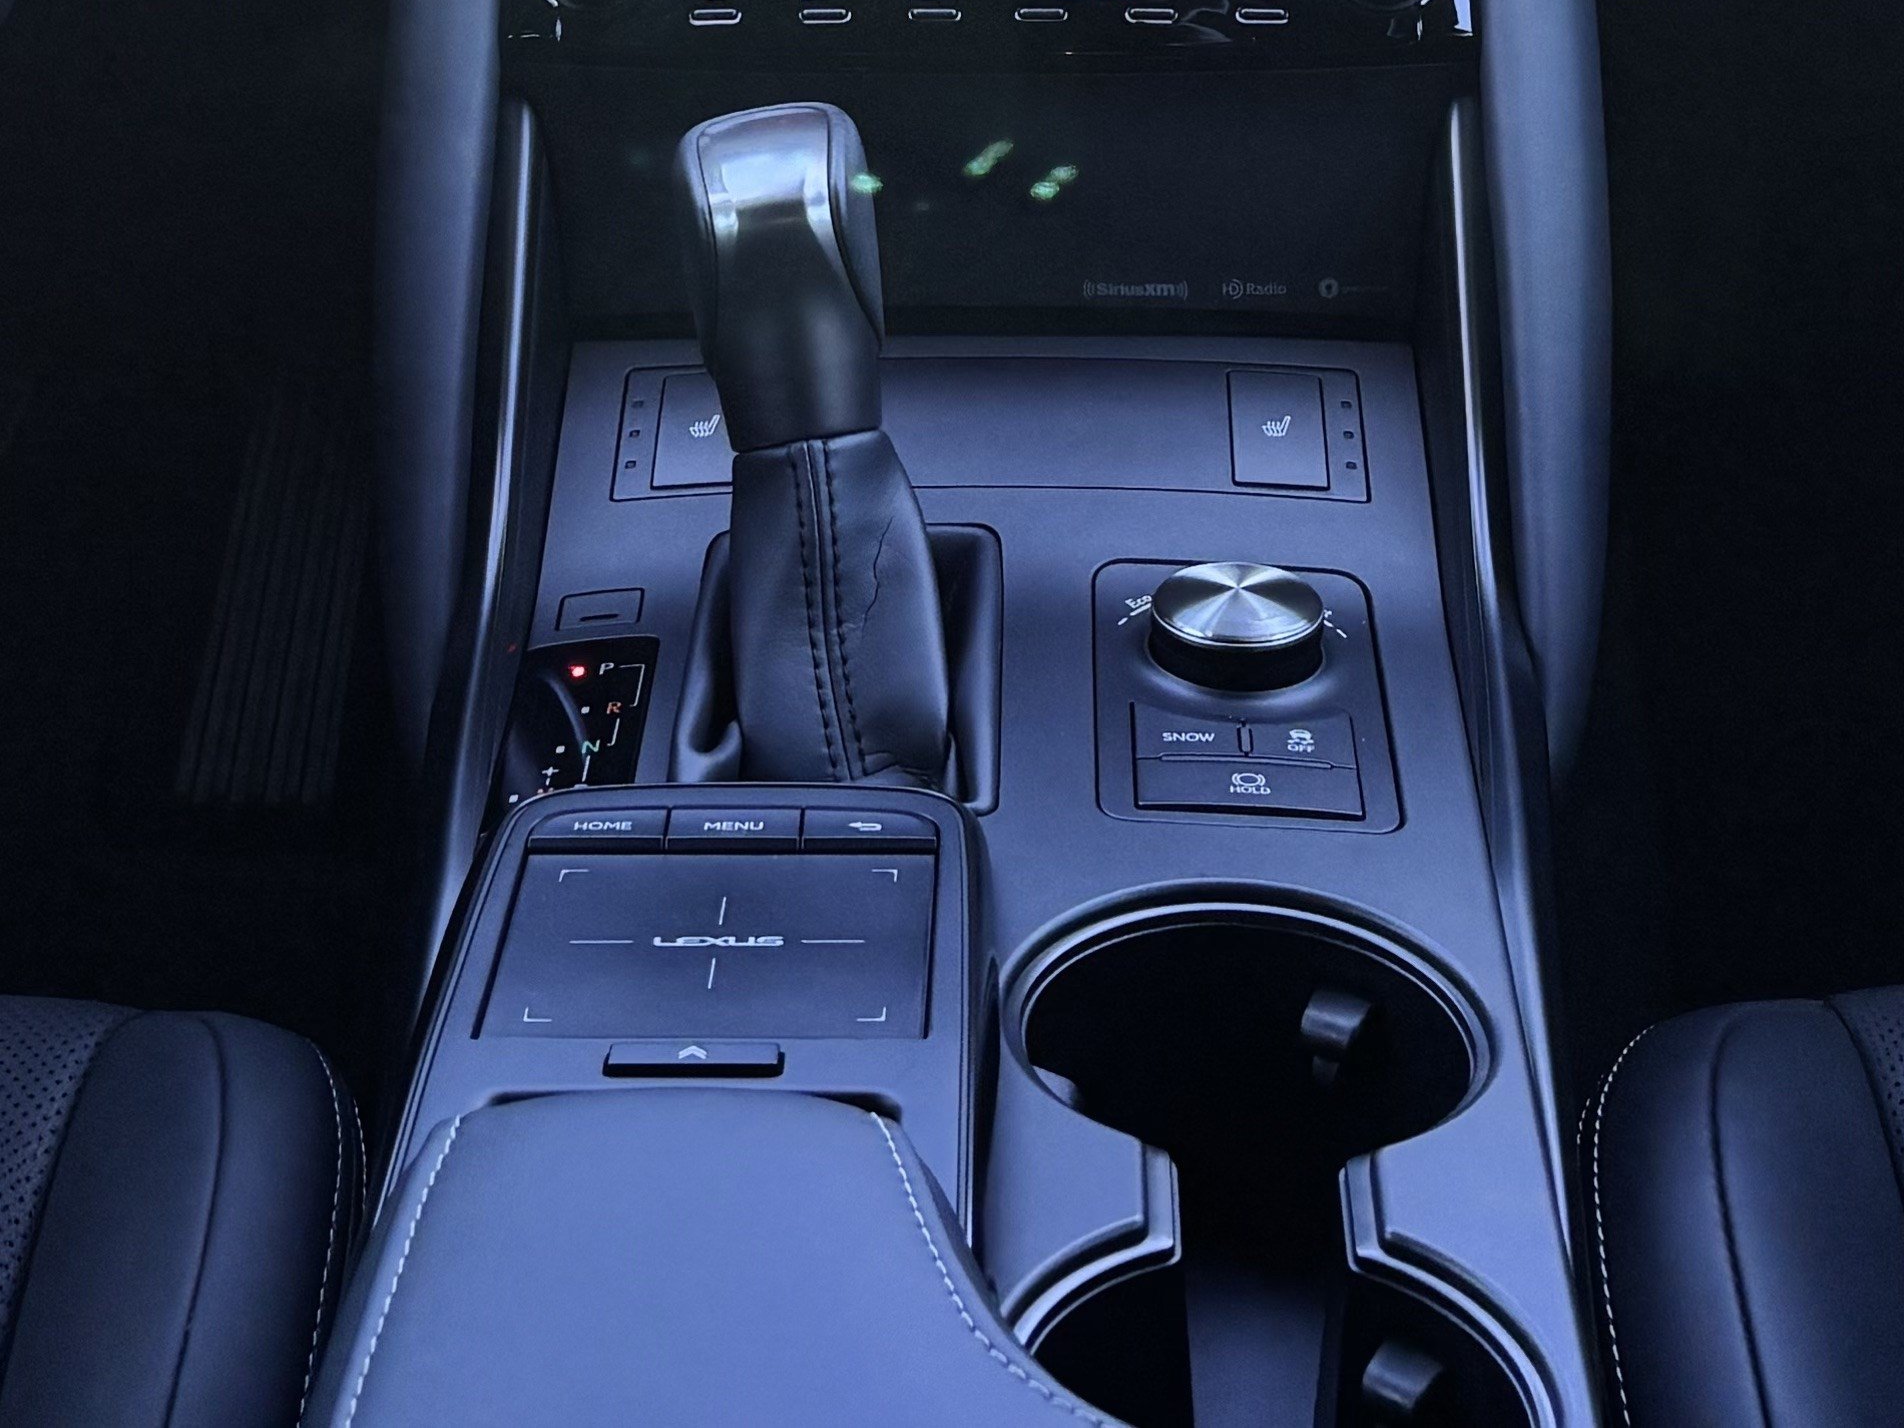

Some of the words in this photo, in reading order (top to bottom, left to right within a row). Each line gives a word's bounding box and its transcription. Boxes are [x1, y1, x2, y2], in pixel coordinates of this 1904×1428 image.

[1124, 594, 1153, 610] Eco
[599, 662, 615, 675] P
[606, 701, 622, 715] R
[1162, 732, 1215, 743] SNOW
[581, 739, 601, 755] N
[1287, 744, 1316, 753] OFF
[1229, 785, 1272, 795] HOLD
[573, 821, 633, 831] HOME
[703, 821, 765, 831] MENU
[652, 935, 785, 947] LEXUS
